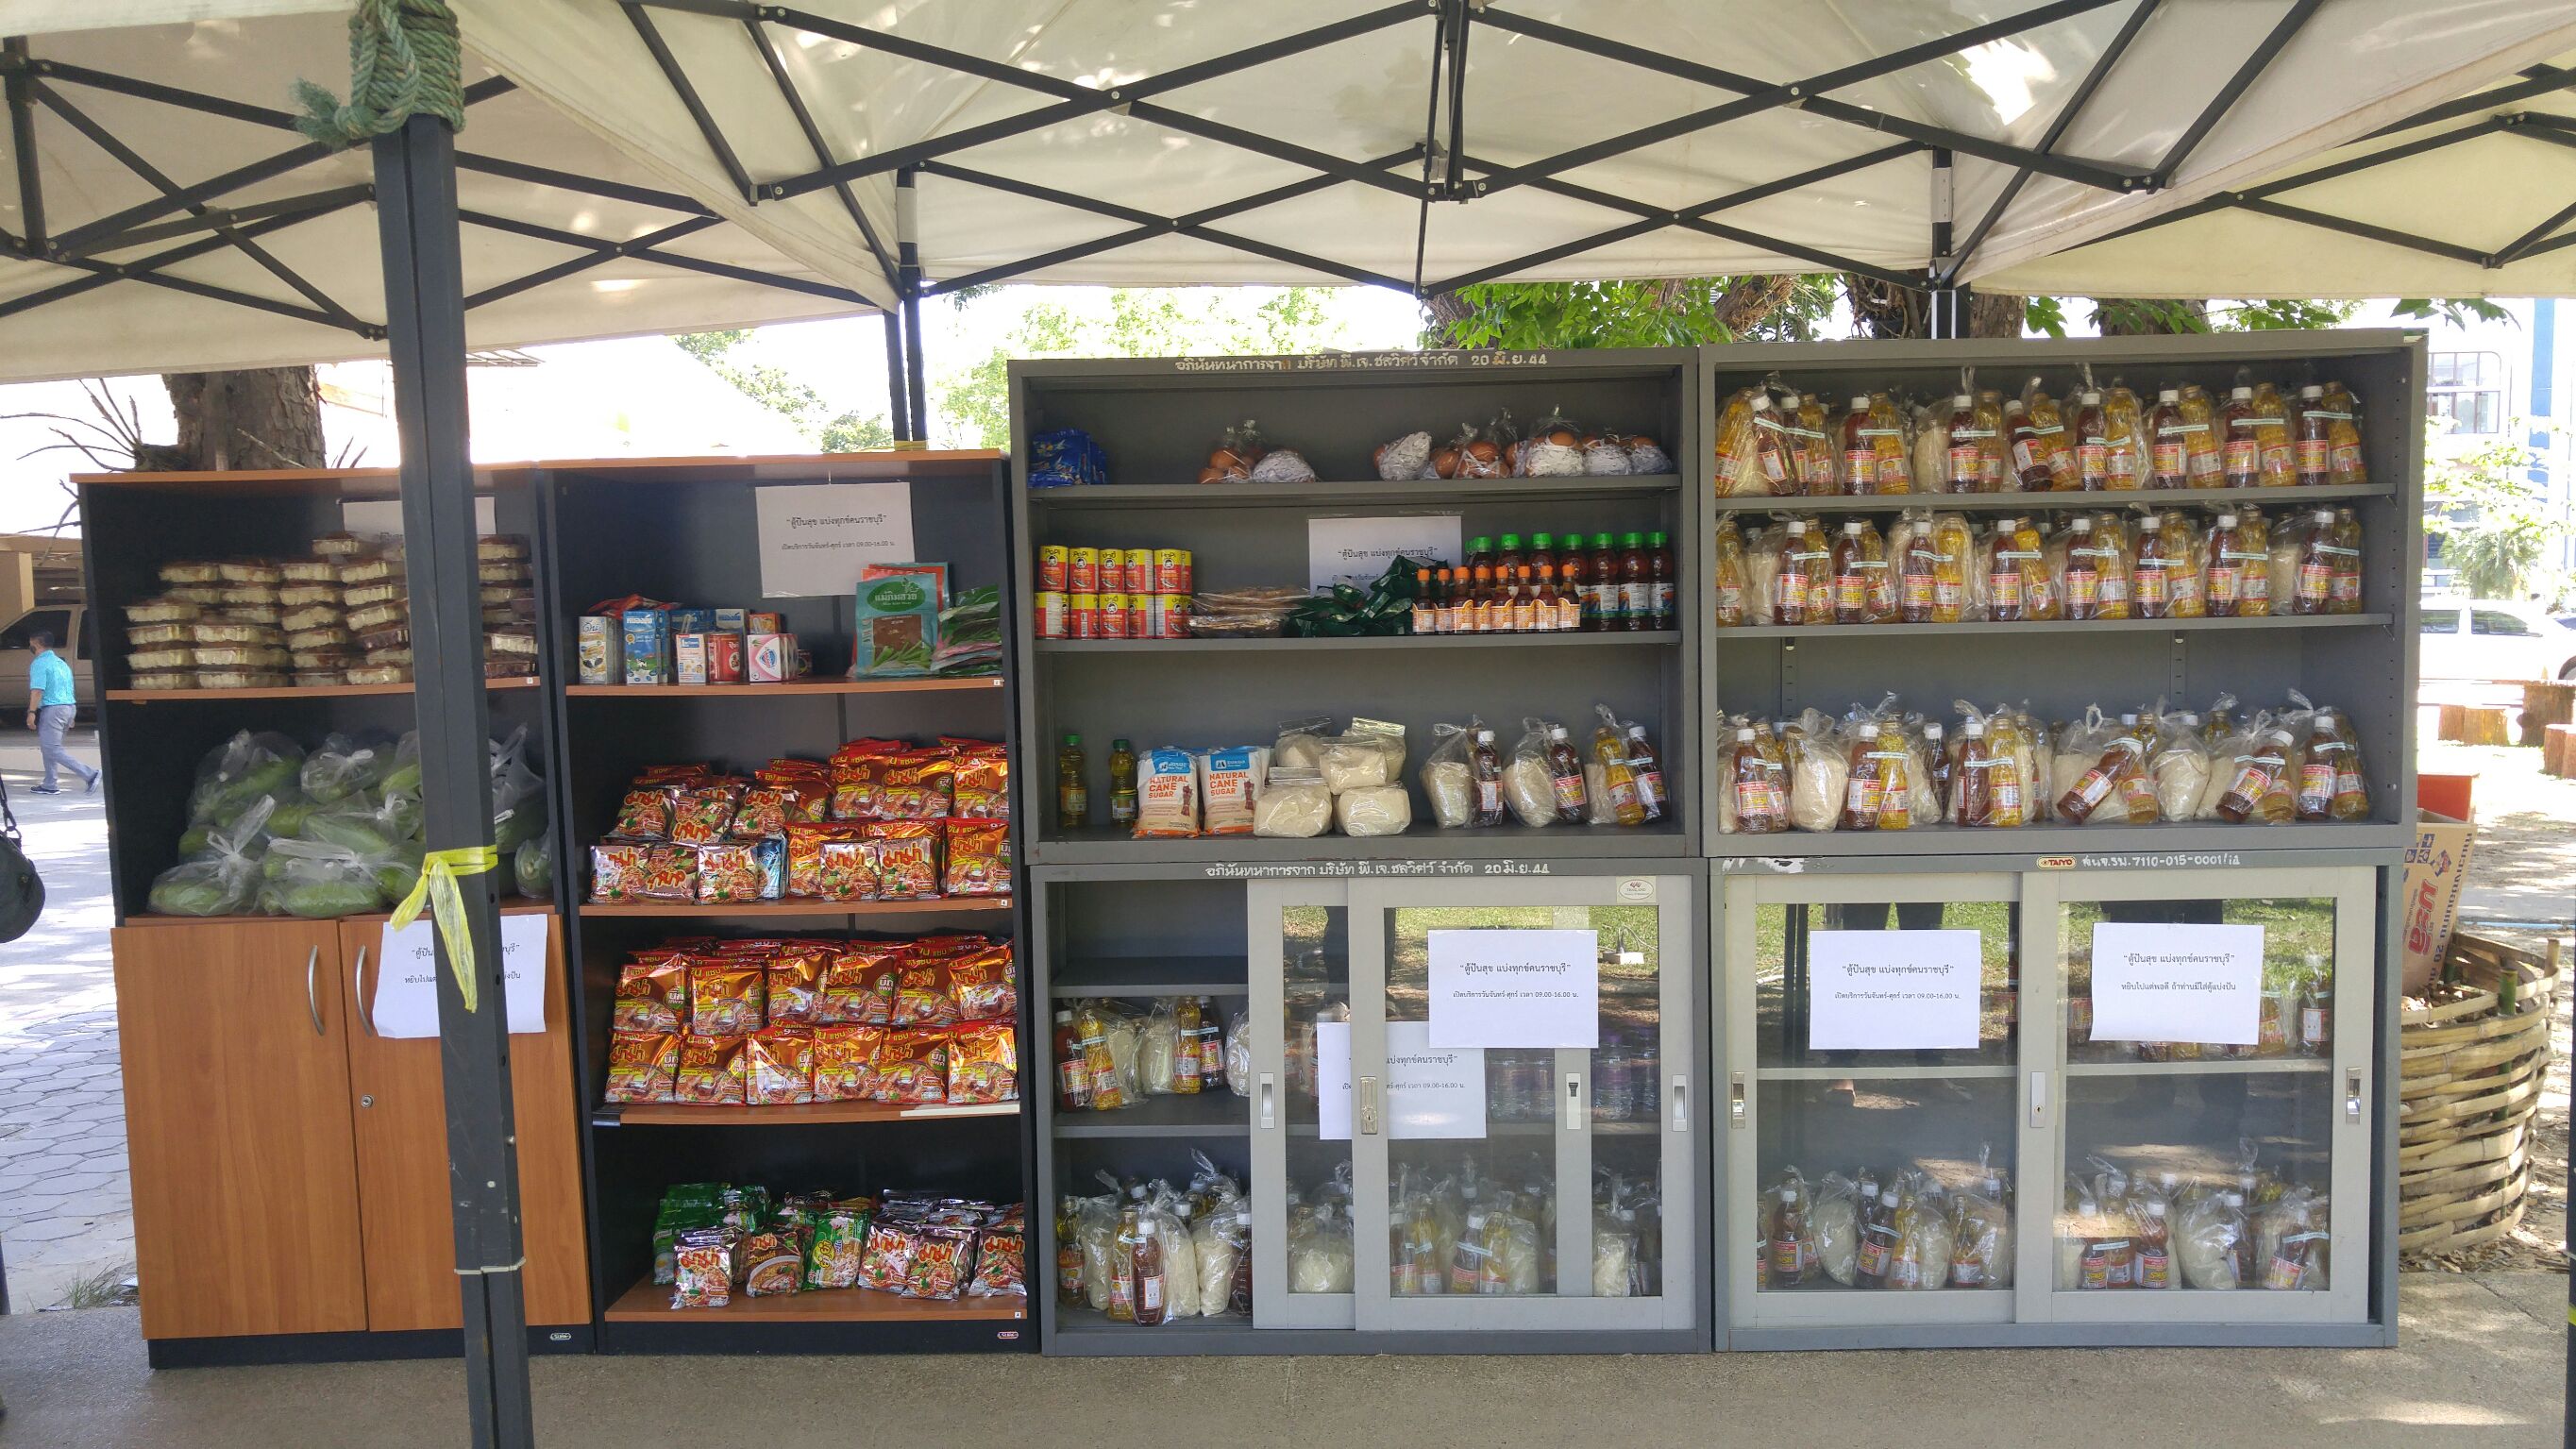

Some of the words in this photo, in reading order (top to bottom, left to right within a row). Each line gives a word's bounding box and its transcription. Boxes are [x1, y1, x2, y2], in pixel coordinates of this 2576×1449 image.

[1471, 355, 1490, 366] 20
[1150, 776, 1188, 784] NATURAL
[1209, 771, 1249, 780] NATURAL
[1149, 782, 1177, 792] CANE
[1209, 779, 1238, 789] CANE
[1210, 787, 1236, 797] SUGAR
[1319, 861, 1355, 876] บริษัท
[1438, 861, 1473, 874] จำกัด
[1485, 863, 1502, 874] 20
